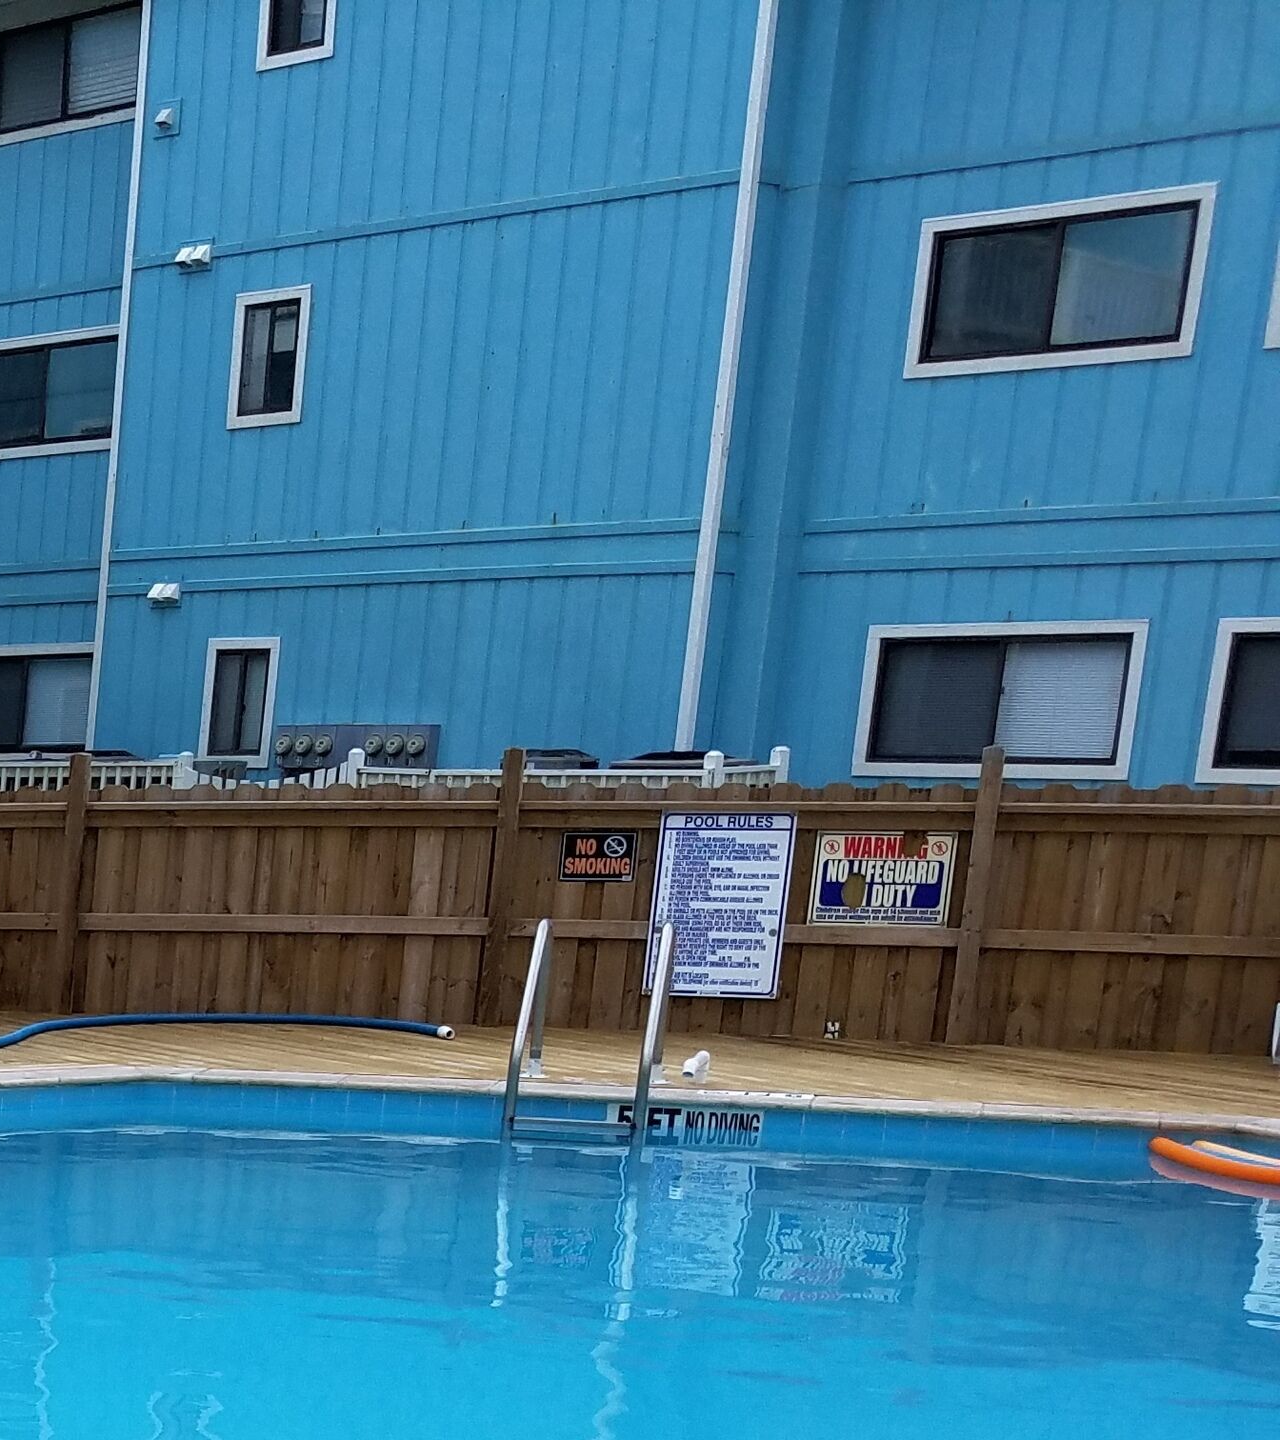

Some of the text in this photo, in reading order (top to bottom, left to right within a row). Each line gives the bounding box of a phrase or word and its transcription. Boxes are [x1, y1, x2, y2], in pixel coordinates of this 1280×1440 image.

[685, 817, 774, 829] POOL RULES
[576, 839, 597, 856] NO
[564, 857, 630, 875] SMOKING
[826, 860, 850, 883] NO
[871, 884, 918, 908] DUTY
